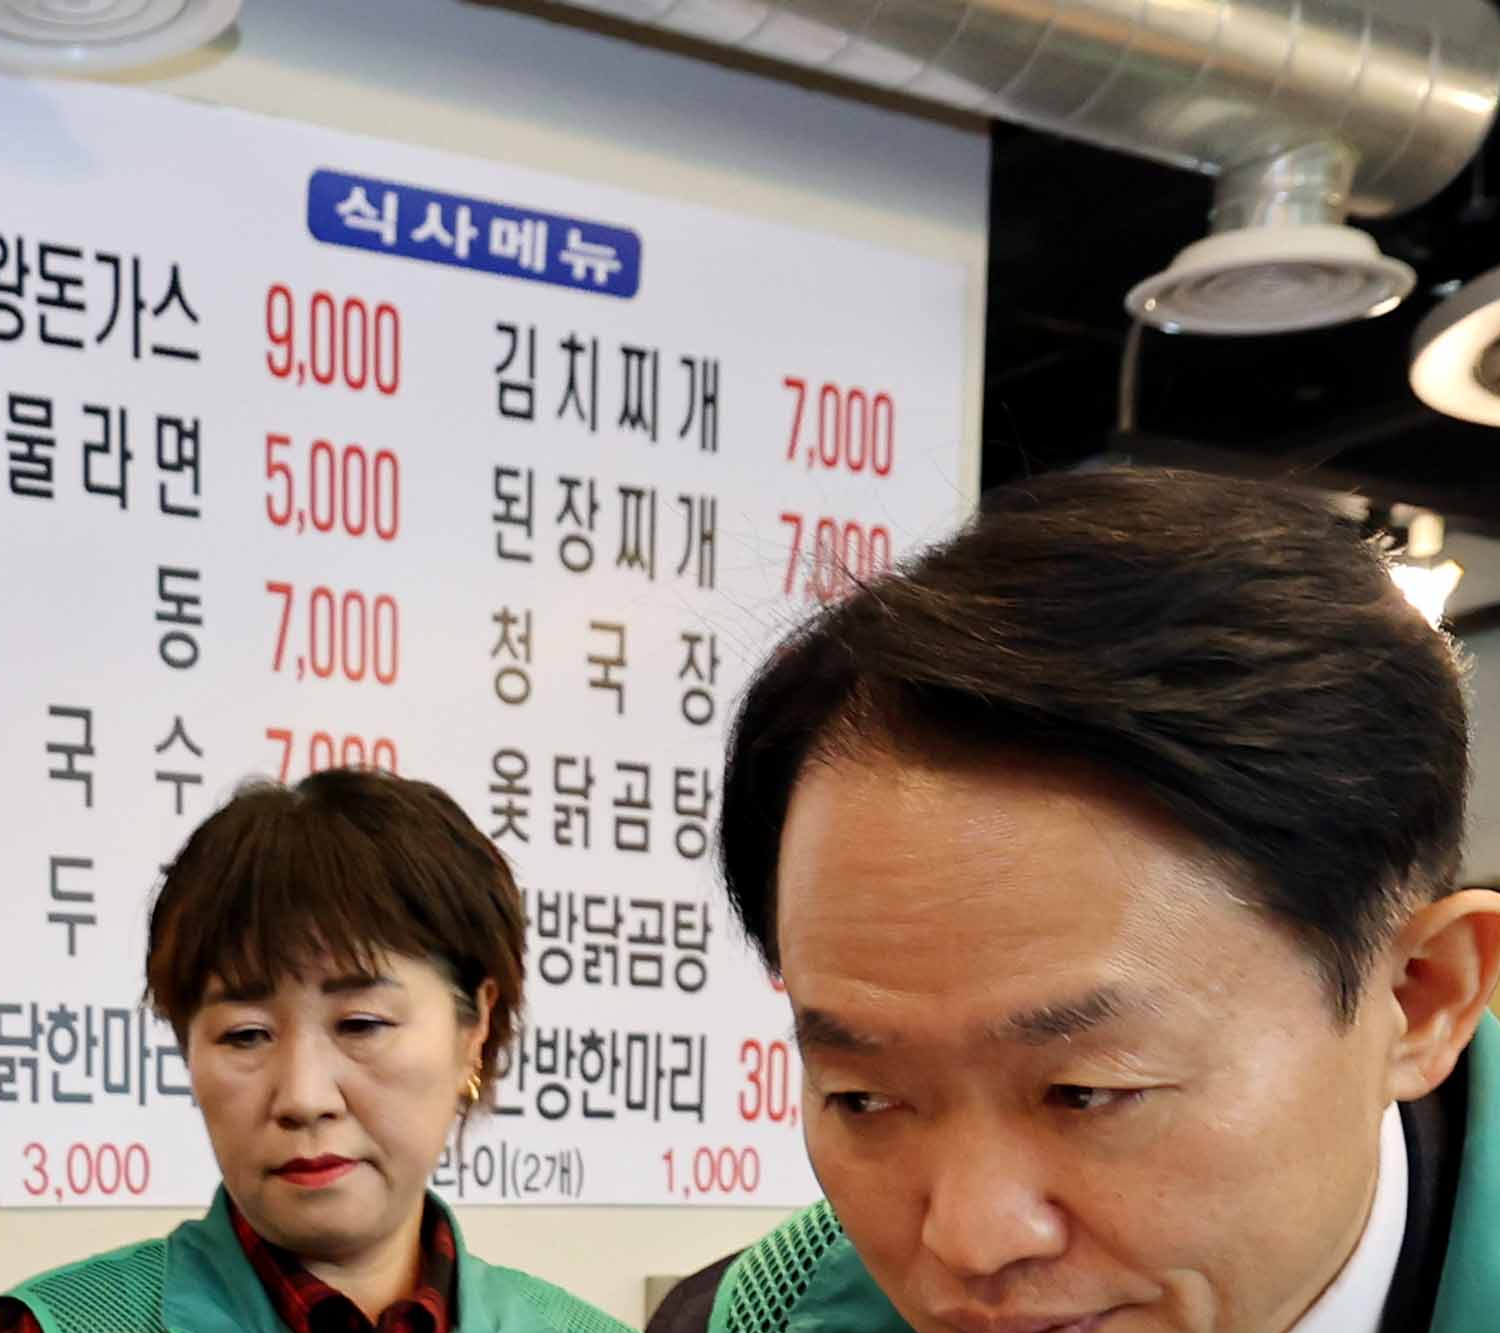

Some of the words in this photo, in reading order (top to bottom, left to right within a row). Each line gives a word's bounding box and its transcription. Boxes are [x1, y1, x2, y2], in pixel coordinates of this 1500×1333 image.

[335, 183, 624, 285] 식사메뉴
[264, 282, 402, 397] 9,000
[492, 320, 721, 455] 김치찌개
[782, 376, 895, 479] 7,000
[264, 431, 401, 543] 5,000
[489, 463, 719, 592] 된장찌개
[264, 579, 401, 686] 7,000
[488, 746, 715, 862] 옻닭곰탕
[520, 886, 713, 994] 방닭곰탕
[21, 1142, 152, 1202] 3,000
[661, 1146, 762, 1199] 1,000
